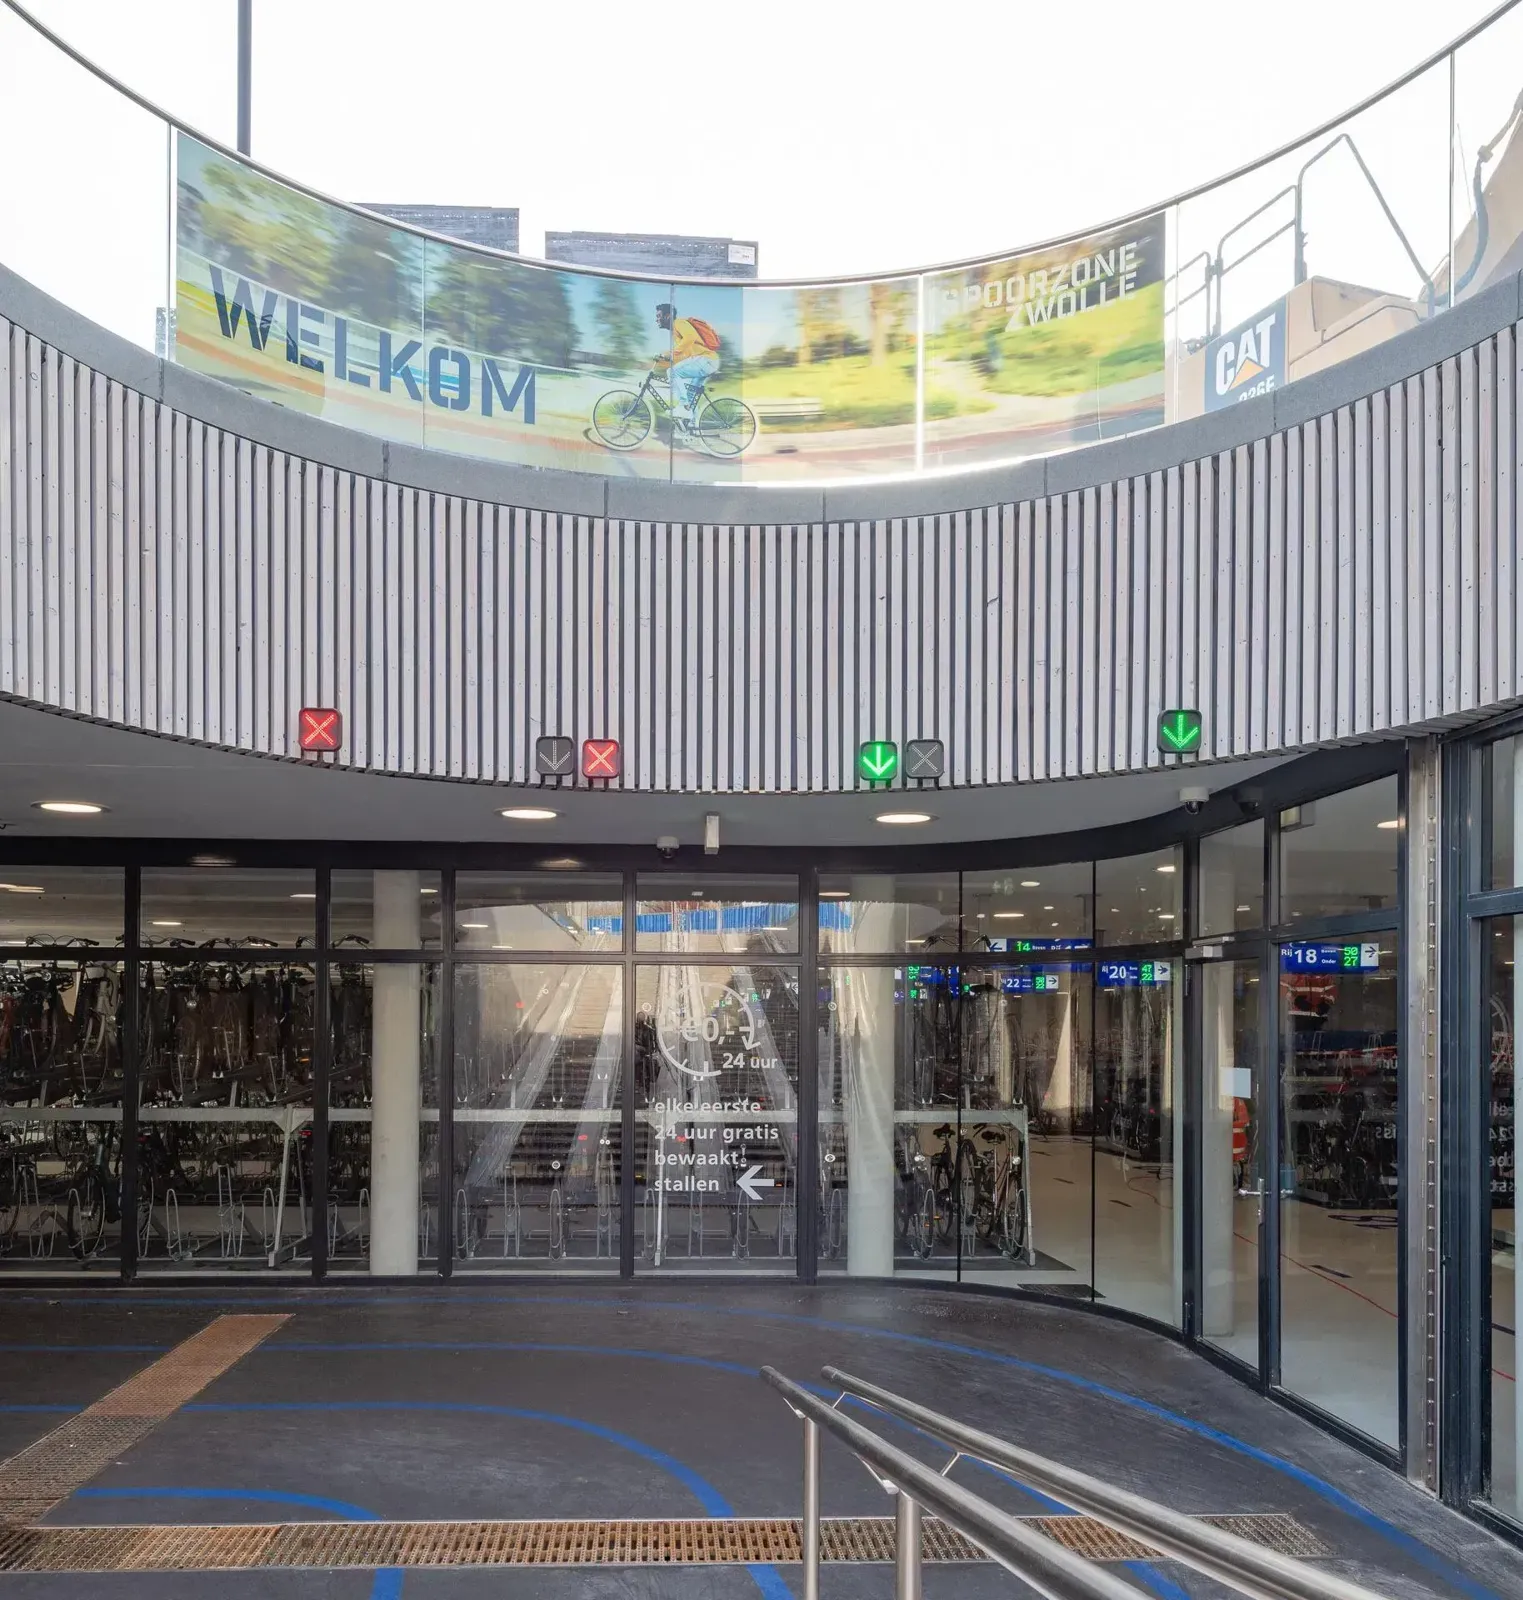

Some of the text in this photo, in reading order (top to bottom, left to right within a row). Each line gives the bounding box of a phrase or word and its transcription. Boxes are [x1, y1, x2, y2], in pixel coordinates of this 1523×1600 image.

[1005, 271, 1137, 332] ZWOLLE
[208, 263, 536, 424] WELKOM
[1216, 312, 1275, 395] CAT
[1281, 949, 1317, 964] Rij 18
[1343, 946, 1358, 956] 50
[1343, 957, 1358, 966] 27
[1109, 966, 1126, 979] 20
[1006, 978, 1020, 988] 22
[722, 1052, 777, 1068] 24 uur
[654, 1098, 761, 1114] elke eerste
[654, 1124, 779, 1143] 24 uur gratis
[654, 1150, 739, 1165] bewaakt
[654, 1175, 720, 1191] stallen
